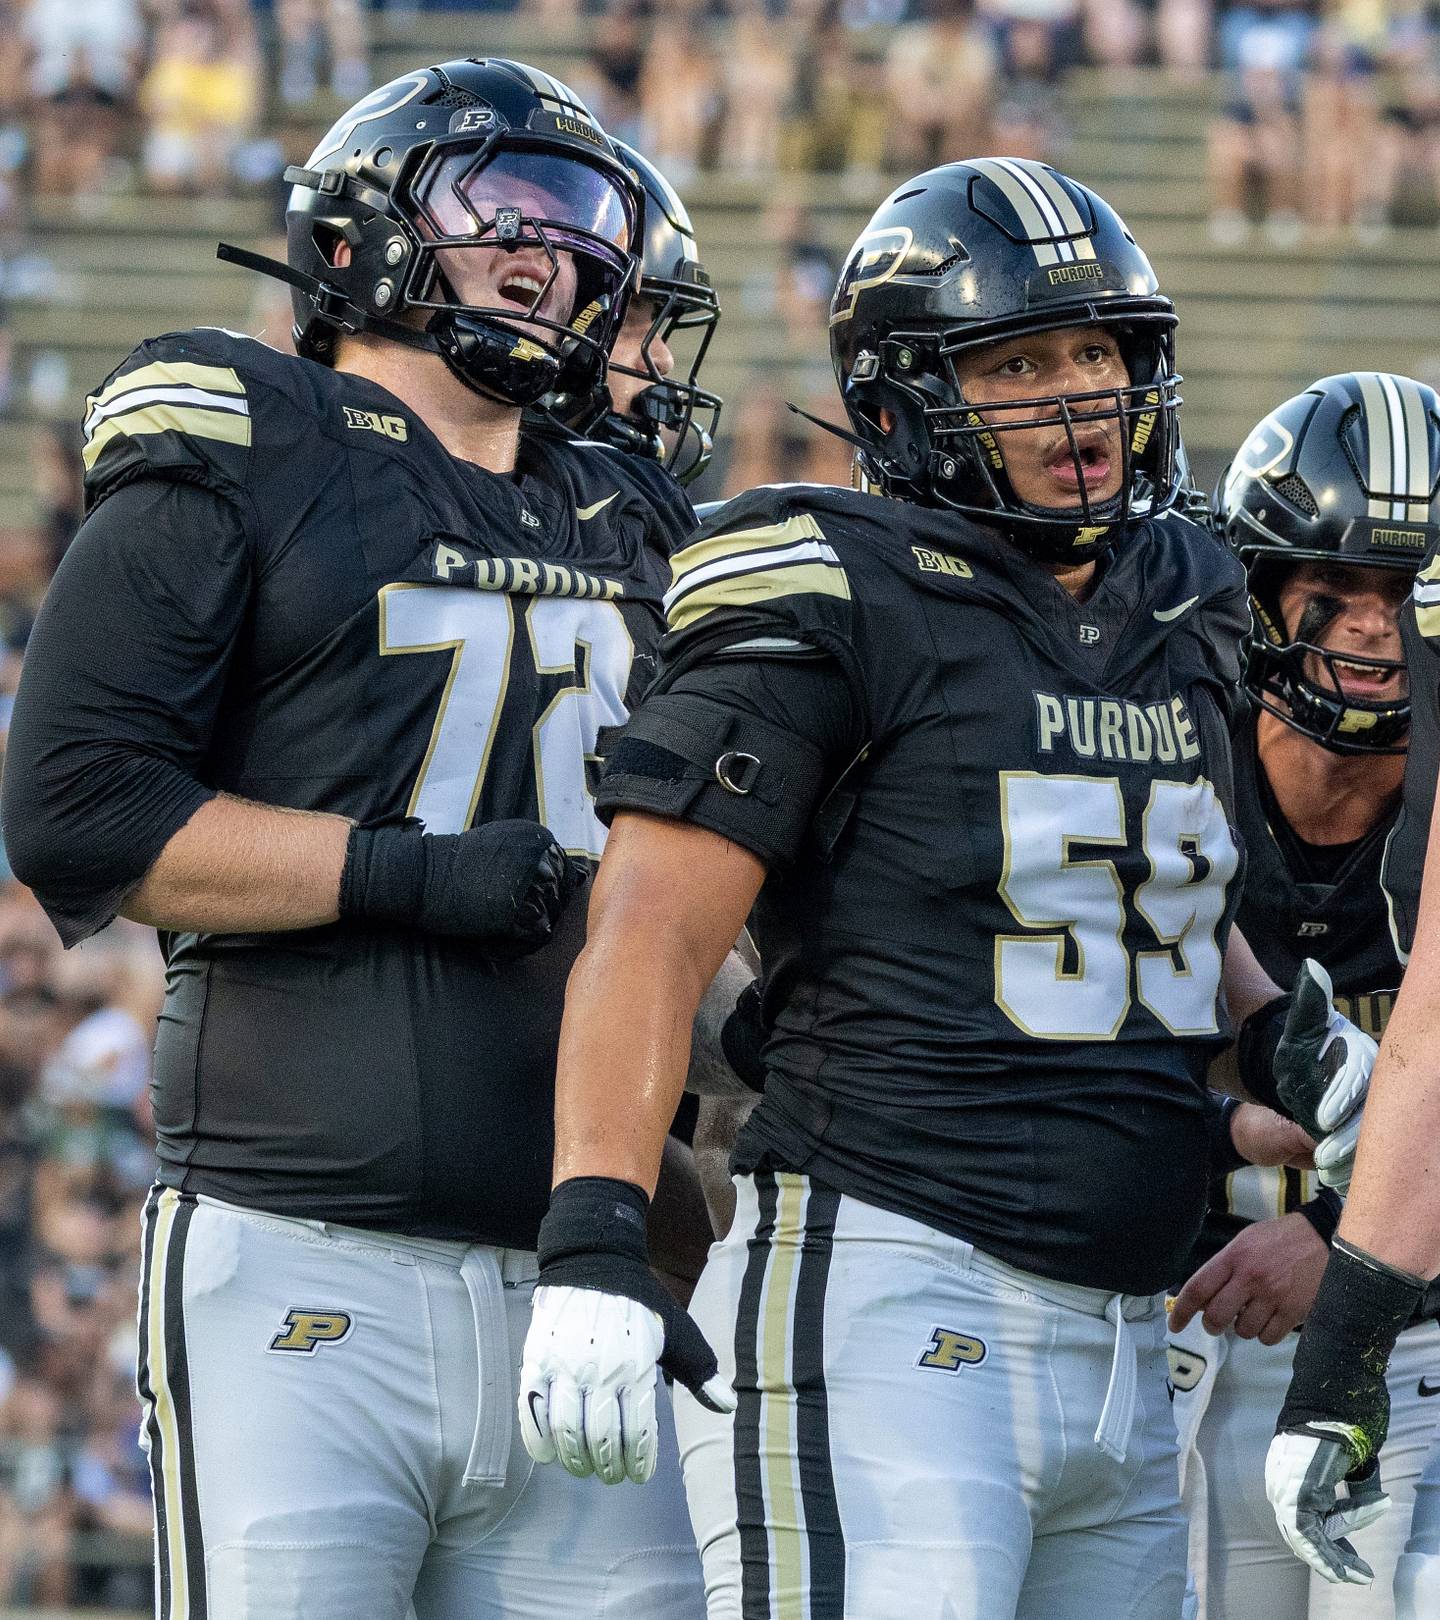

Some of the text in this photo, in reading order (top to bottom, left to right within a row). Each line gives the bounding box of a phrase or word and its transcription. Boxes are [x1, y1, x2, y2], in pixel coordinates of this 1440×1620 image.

[555, 116, 603, 145] PURDUE
[1048, 264, 1104, 286] PURDUE
[1132, 410, 1158, 455] BOILE
[1370, 528, 1426, 548] PURDUE
[378, 582, 635, 861] 72
[1033, 690, 1202, 765] PURDUE
[994, 770, 1240, 1041] 59
[266, 1306, 355, 1357] P
[915, 1325, 988, 1375] P
